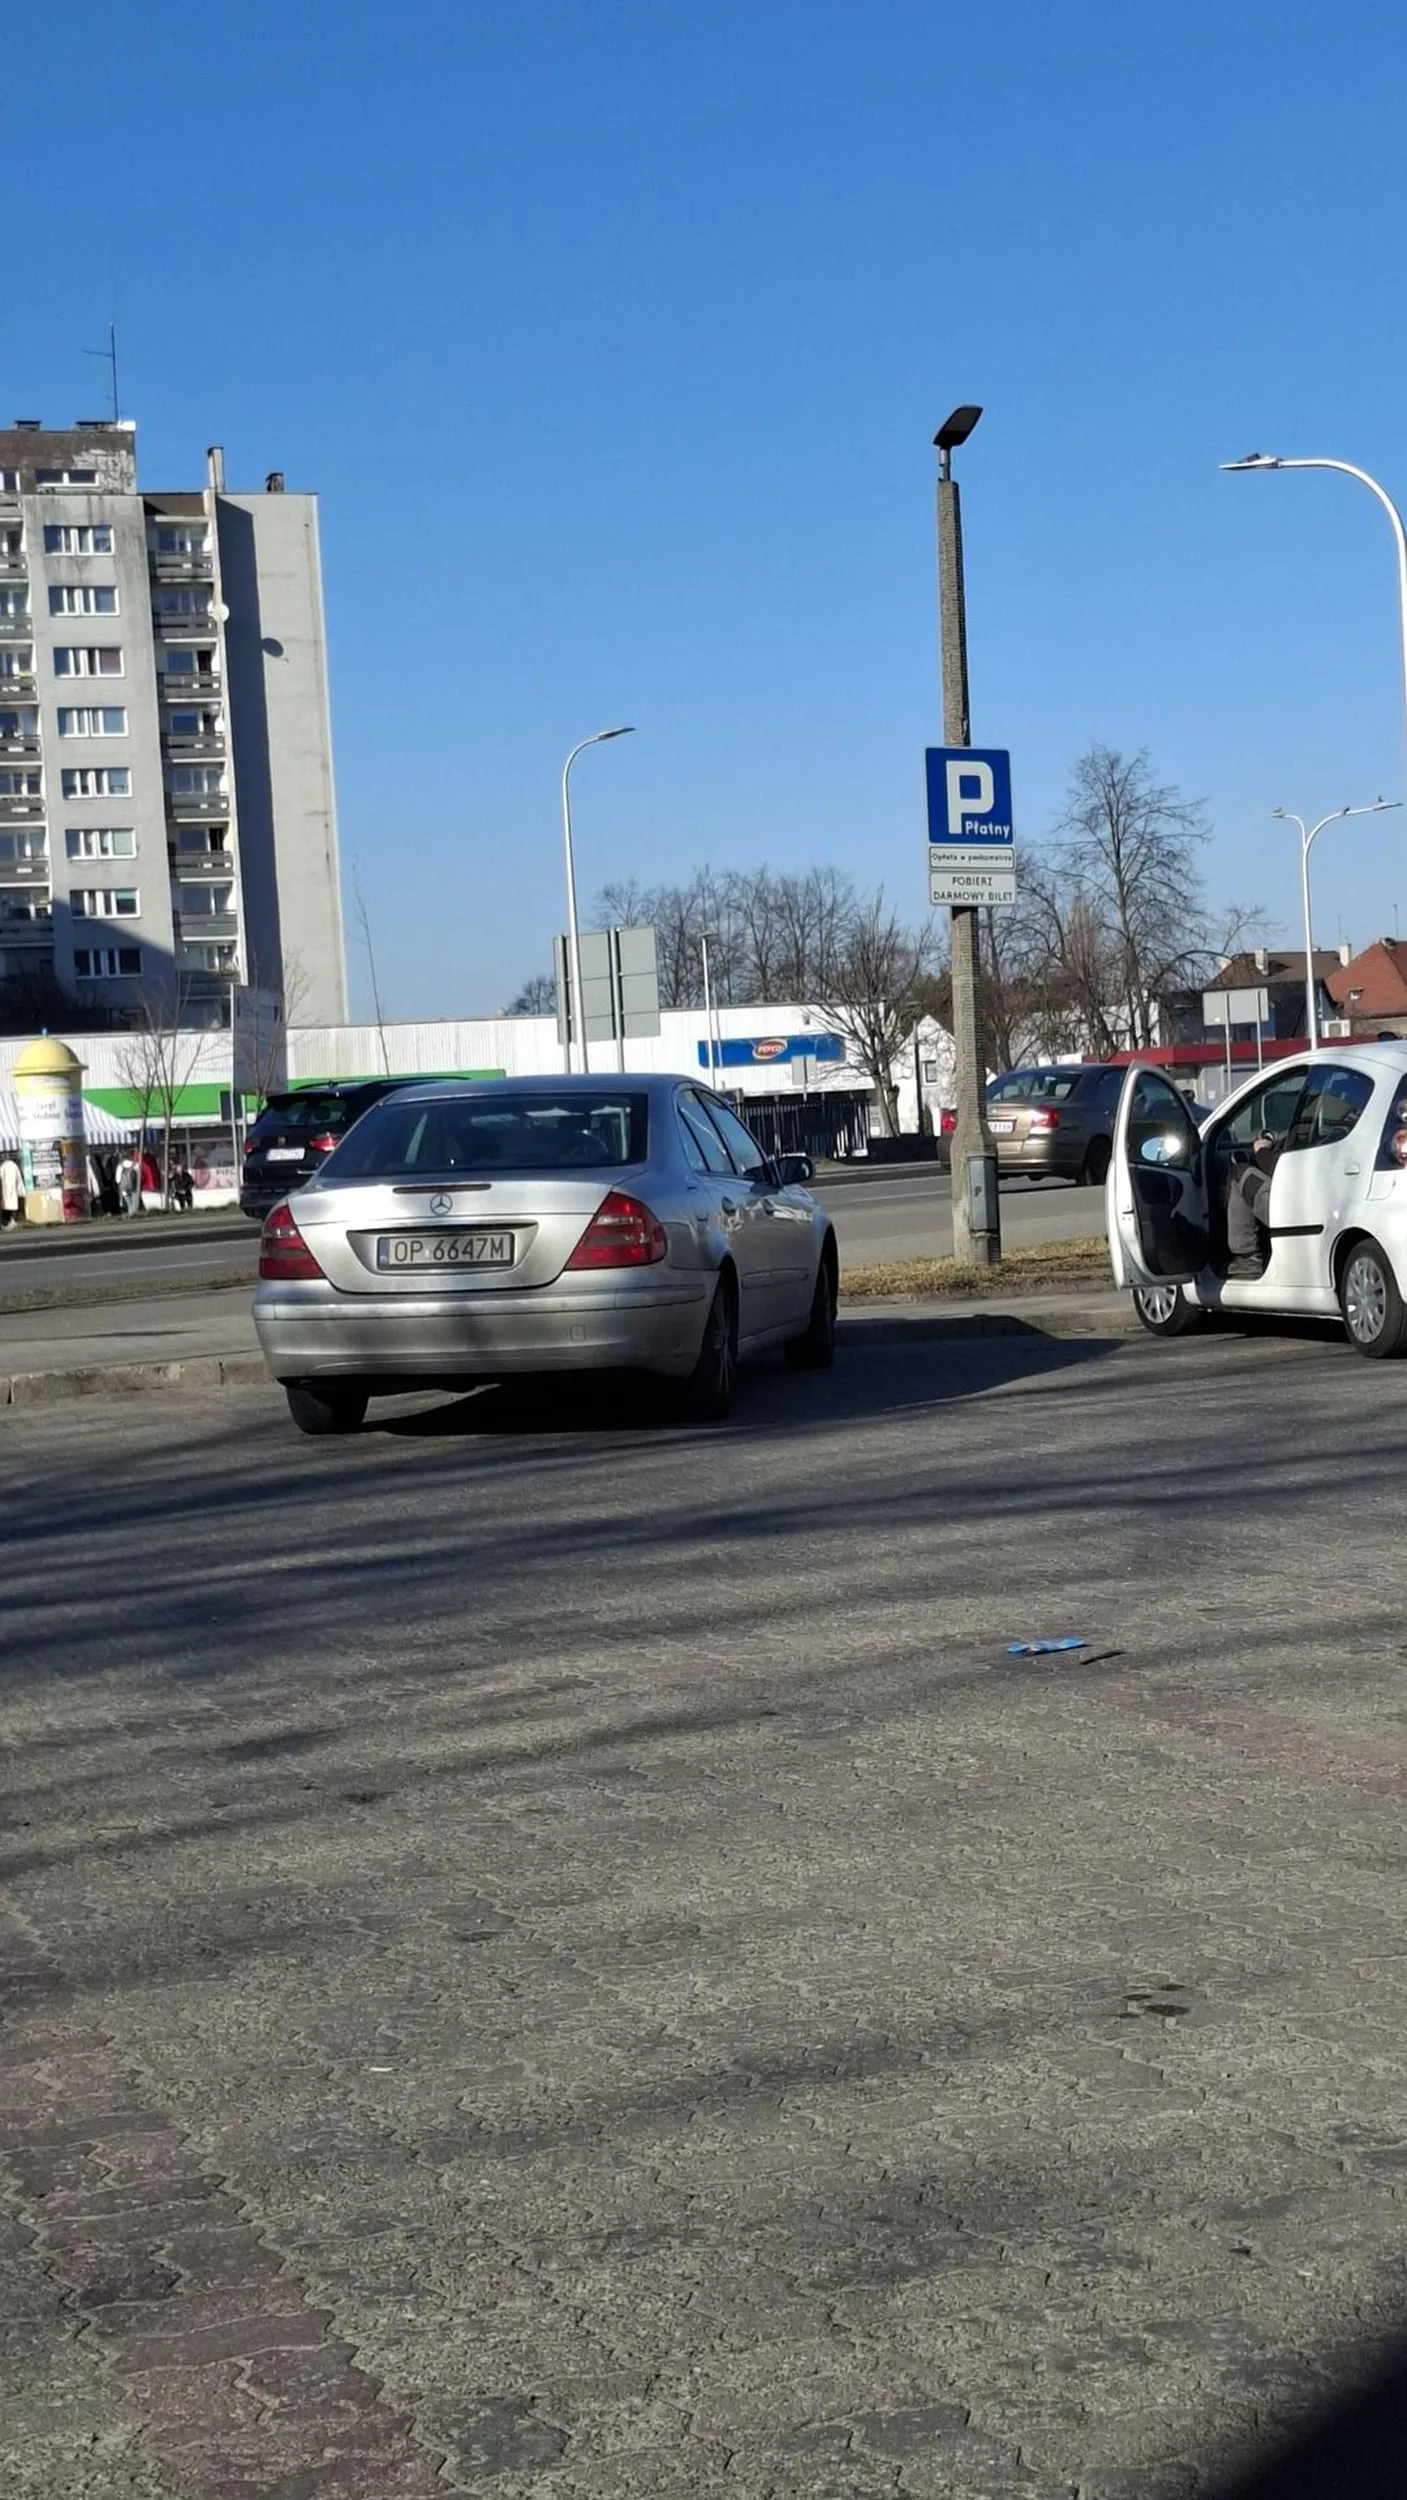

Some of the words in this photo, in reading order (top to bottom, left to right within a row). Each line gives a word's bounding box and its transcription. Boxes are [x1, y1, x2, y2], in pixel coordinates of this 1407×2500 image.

[946, 760, 995, 834] P
[965, 821, 1010, 838] Płatny
[952, 876, 993, 886] POBIERZ
[933, 891, 985, 901] DARMOWY
[988, 891, 1012, 901] BILET
[394, 1240, 423, 1262] OP
[433, 1237, 504, 1261] 6647M
